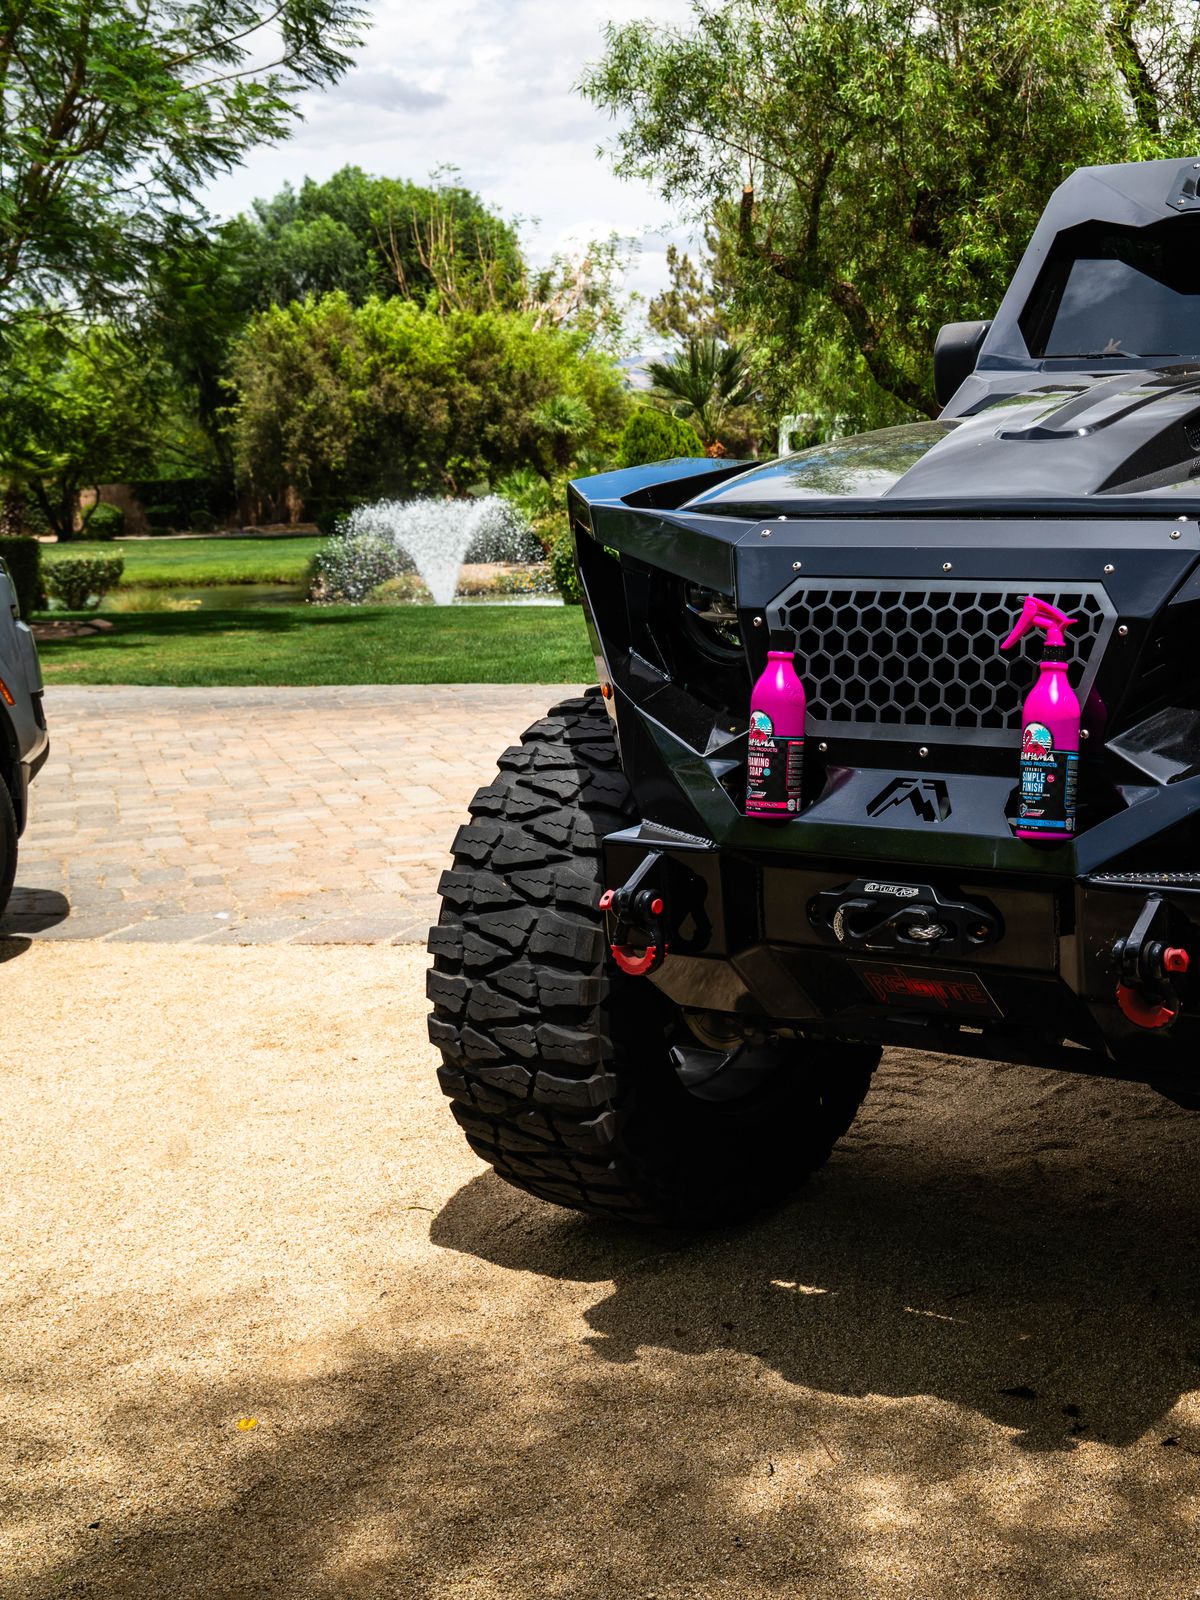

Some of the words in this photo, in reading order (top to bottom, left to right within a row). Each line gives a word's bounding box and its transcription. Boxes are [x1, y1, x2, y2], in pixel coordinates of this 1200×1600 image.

[1020, 752, 1054, 761] BAHAMA
[750, 767, 762, 776] SOAP
[1022, 772, 1045, 782] SIMPLE
[1022, 782, 1043, 792] FINISH
